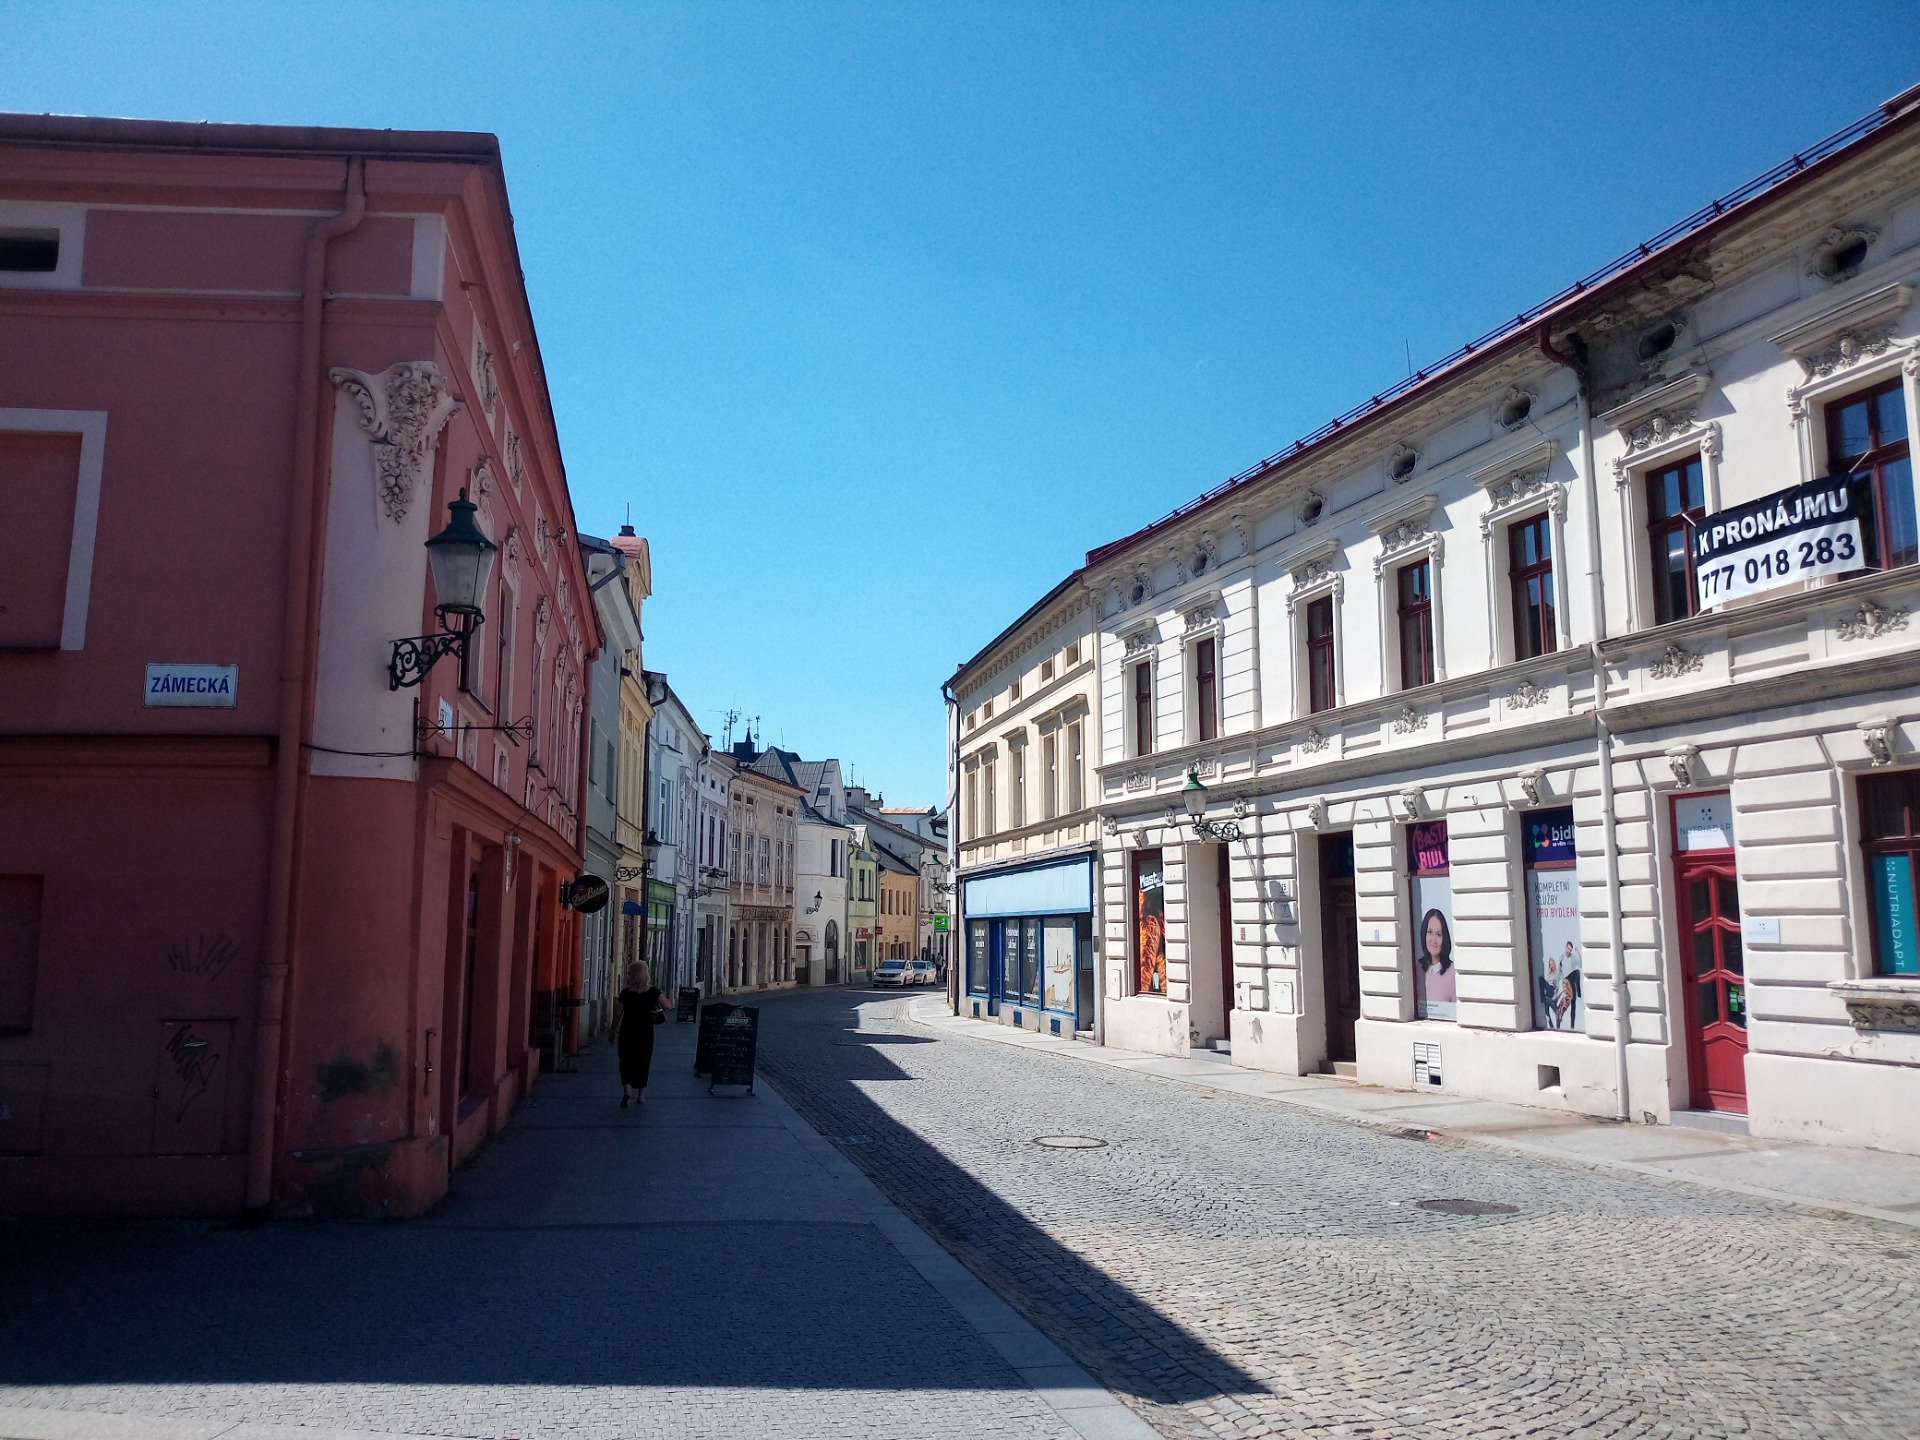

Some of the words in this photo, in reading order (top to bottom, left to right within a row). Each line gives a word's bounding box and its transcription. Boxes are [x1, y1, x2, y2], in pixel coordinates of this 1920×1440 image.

[1698, 529, 1710, 556] K
[1712, 487, 1848, 549] PRONÁJMU
[1702, 564, 1735, 599] 777
[1744, 549, 1790, 584] 018
[1797, 533, 1856, 570] 283
[151, 673, 230, 693] ZÁMECKÁ
[1534, 878, 1570, 893] KOMPLETNÍ
[1535, 893, 1558, 906] SLUŽBY
[1536, 907, 1548, 918] PRO
[1551, 904, 1578, 918] BYDLENÍ
[1886, 873, 1905, 968] NUTRIADAPT
